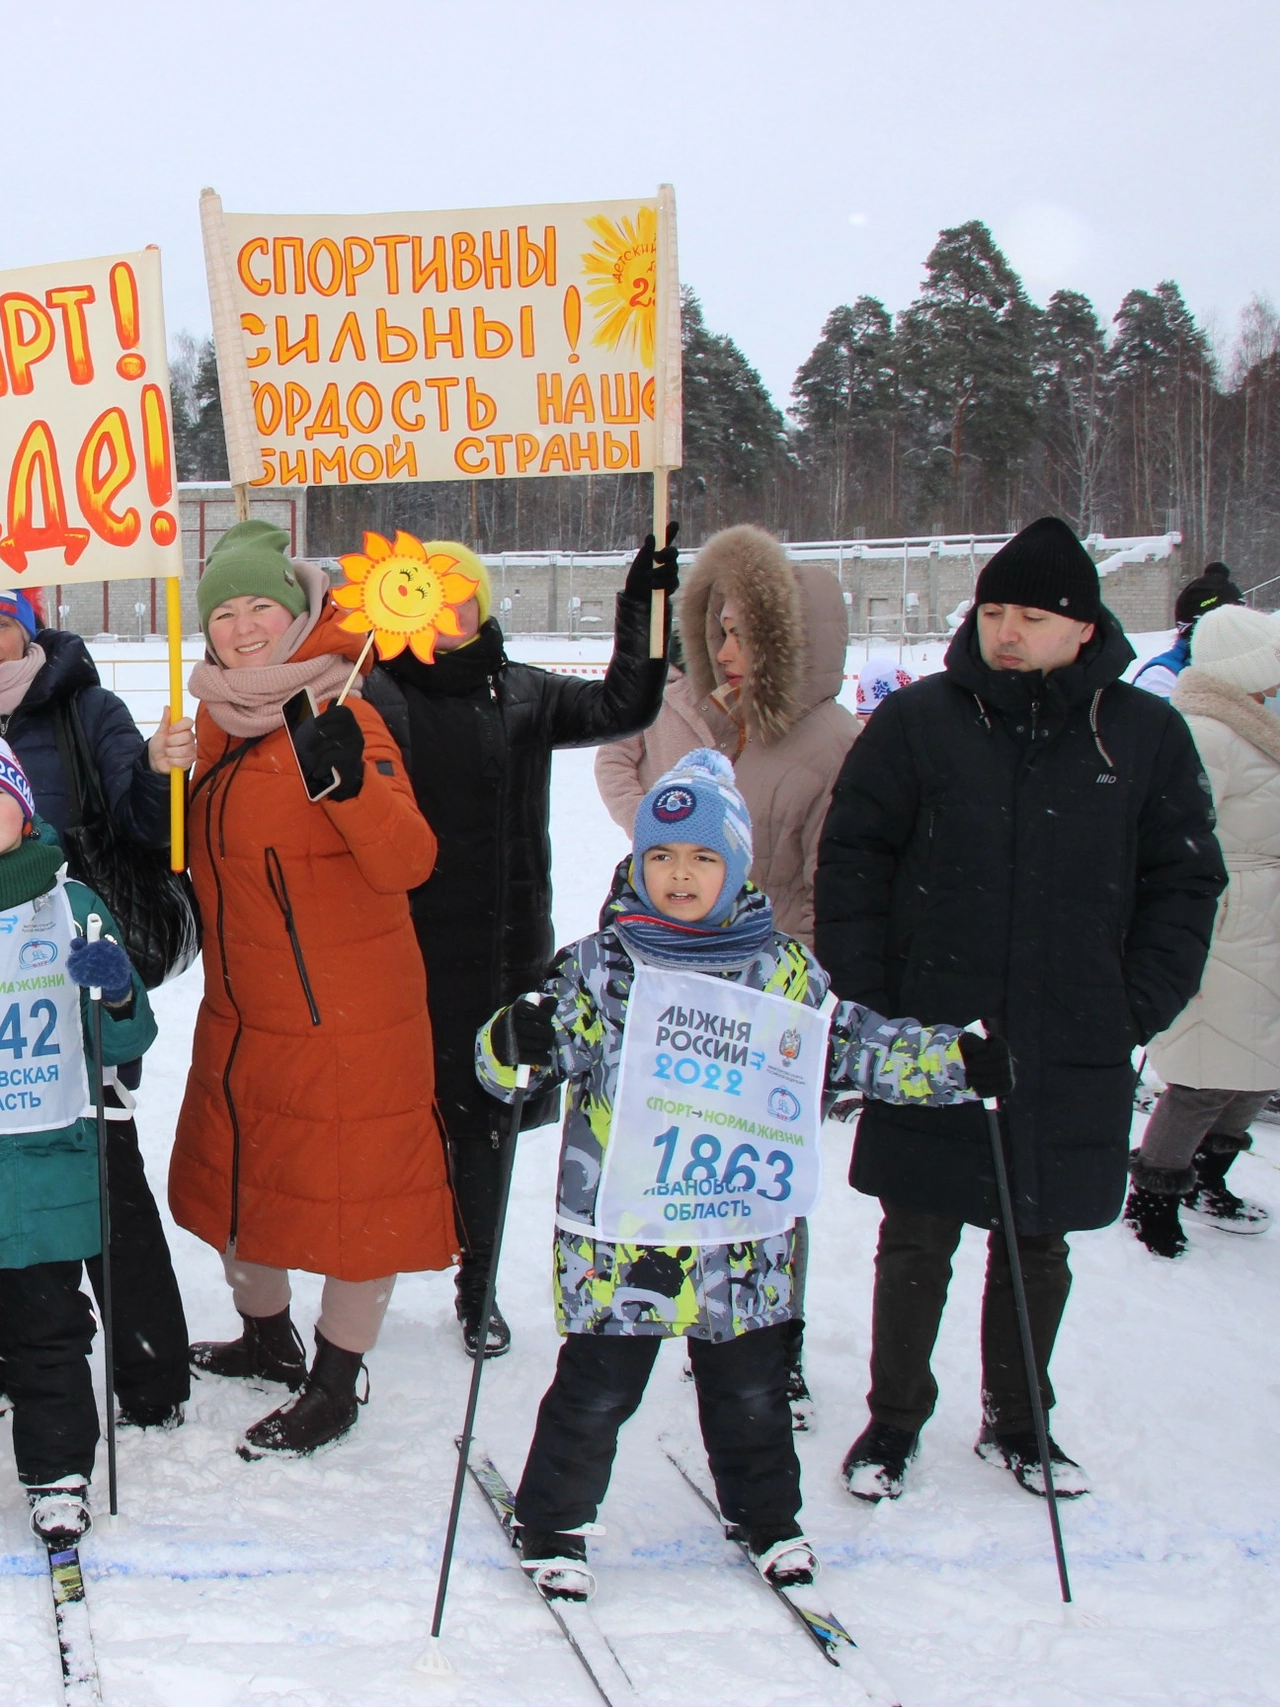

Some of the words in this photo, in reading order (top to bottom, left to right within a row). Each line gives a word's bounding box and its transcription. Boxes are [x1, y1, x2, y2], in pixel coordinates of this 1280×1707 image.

[237, 225, 556, 297] СПОРТИВНЫ
[252, 376, 497, 441] ОРДОСТЬ
[454, 429, 640, 476] СТРАНЫ
[17, 973, 65, 991] ЖИЗНИ
[656, 1025, 748, 1067] РОССИИ
[657, 1006, 752, 1044] ЛЫЖНЯ
[652, 1053, 743, 1097] 2022
[646, 1096, 694, 1118] СПОРТ
[703, 1109, 756, 1134] НОРМА
[756, 1124, 804, 1147] ЖИЗНИ
[653, 1125, 794, 1201] 1863
[663, 1199, 751, 1221] ОБЛАСТЬ
